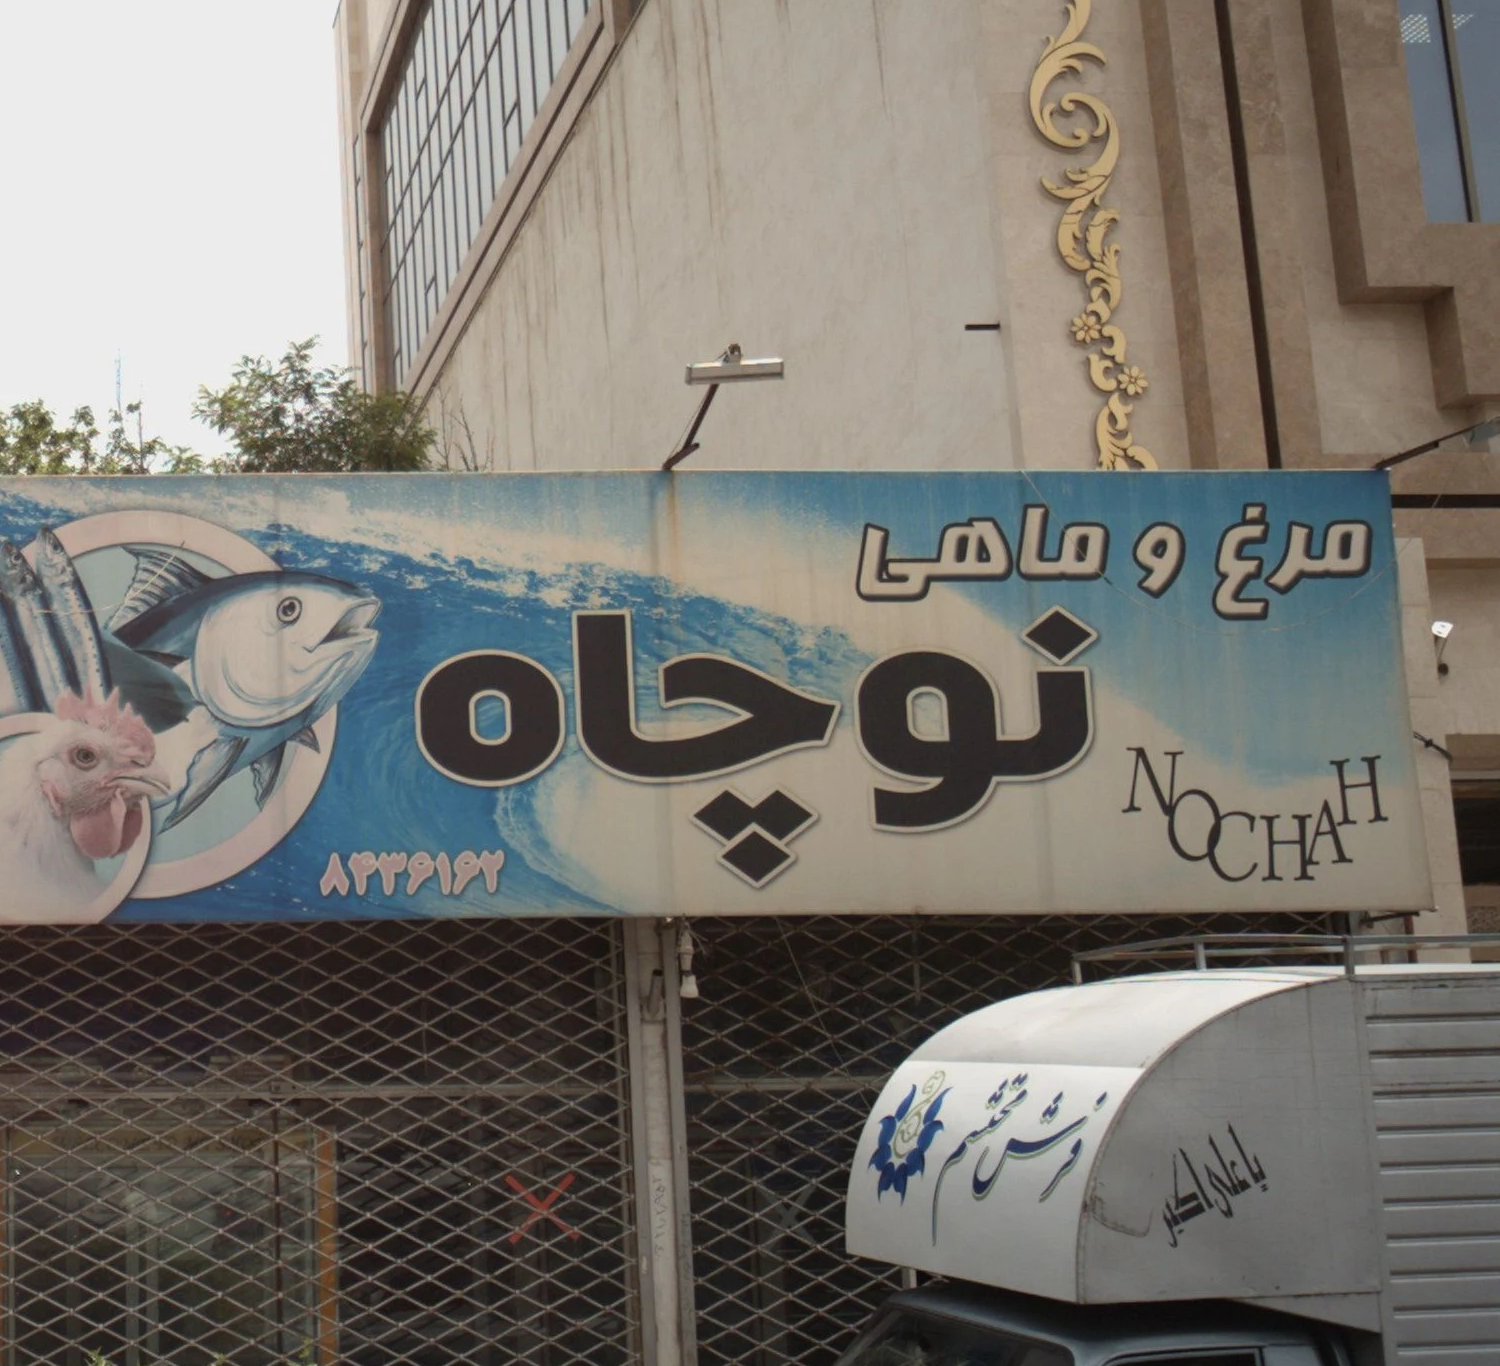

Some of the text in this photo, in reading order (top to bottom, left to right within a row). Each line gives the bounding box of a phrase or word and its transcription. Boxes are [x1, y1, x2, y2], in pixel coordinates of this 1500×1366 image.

[855, 502, 1373, 620] مرغ و ماهی
[415, 603, 1099, 889] نوچاه
[318, 849, 505, 897] ۸۴۳۶۱۶۲
[1121, 746, 1389, 883] NOCHAH
